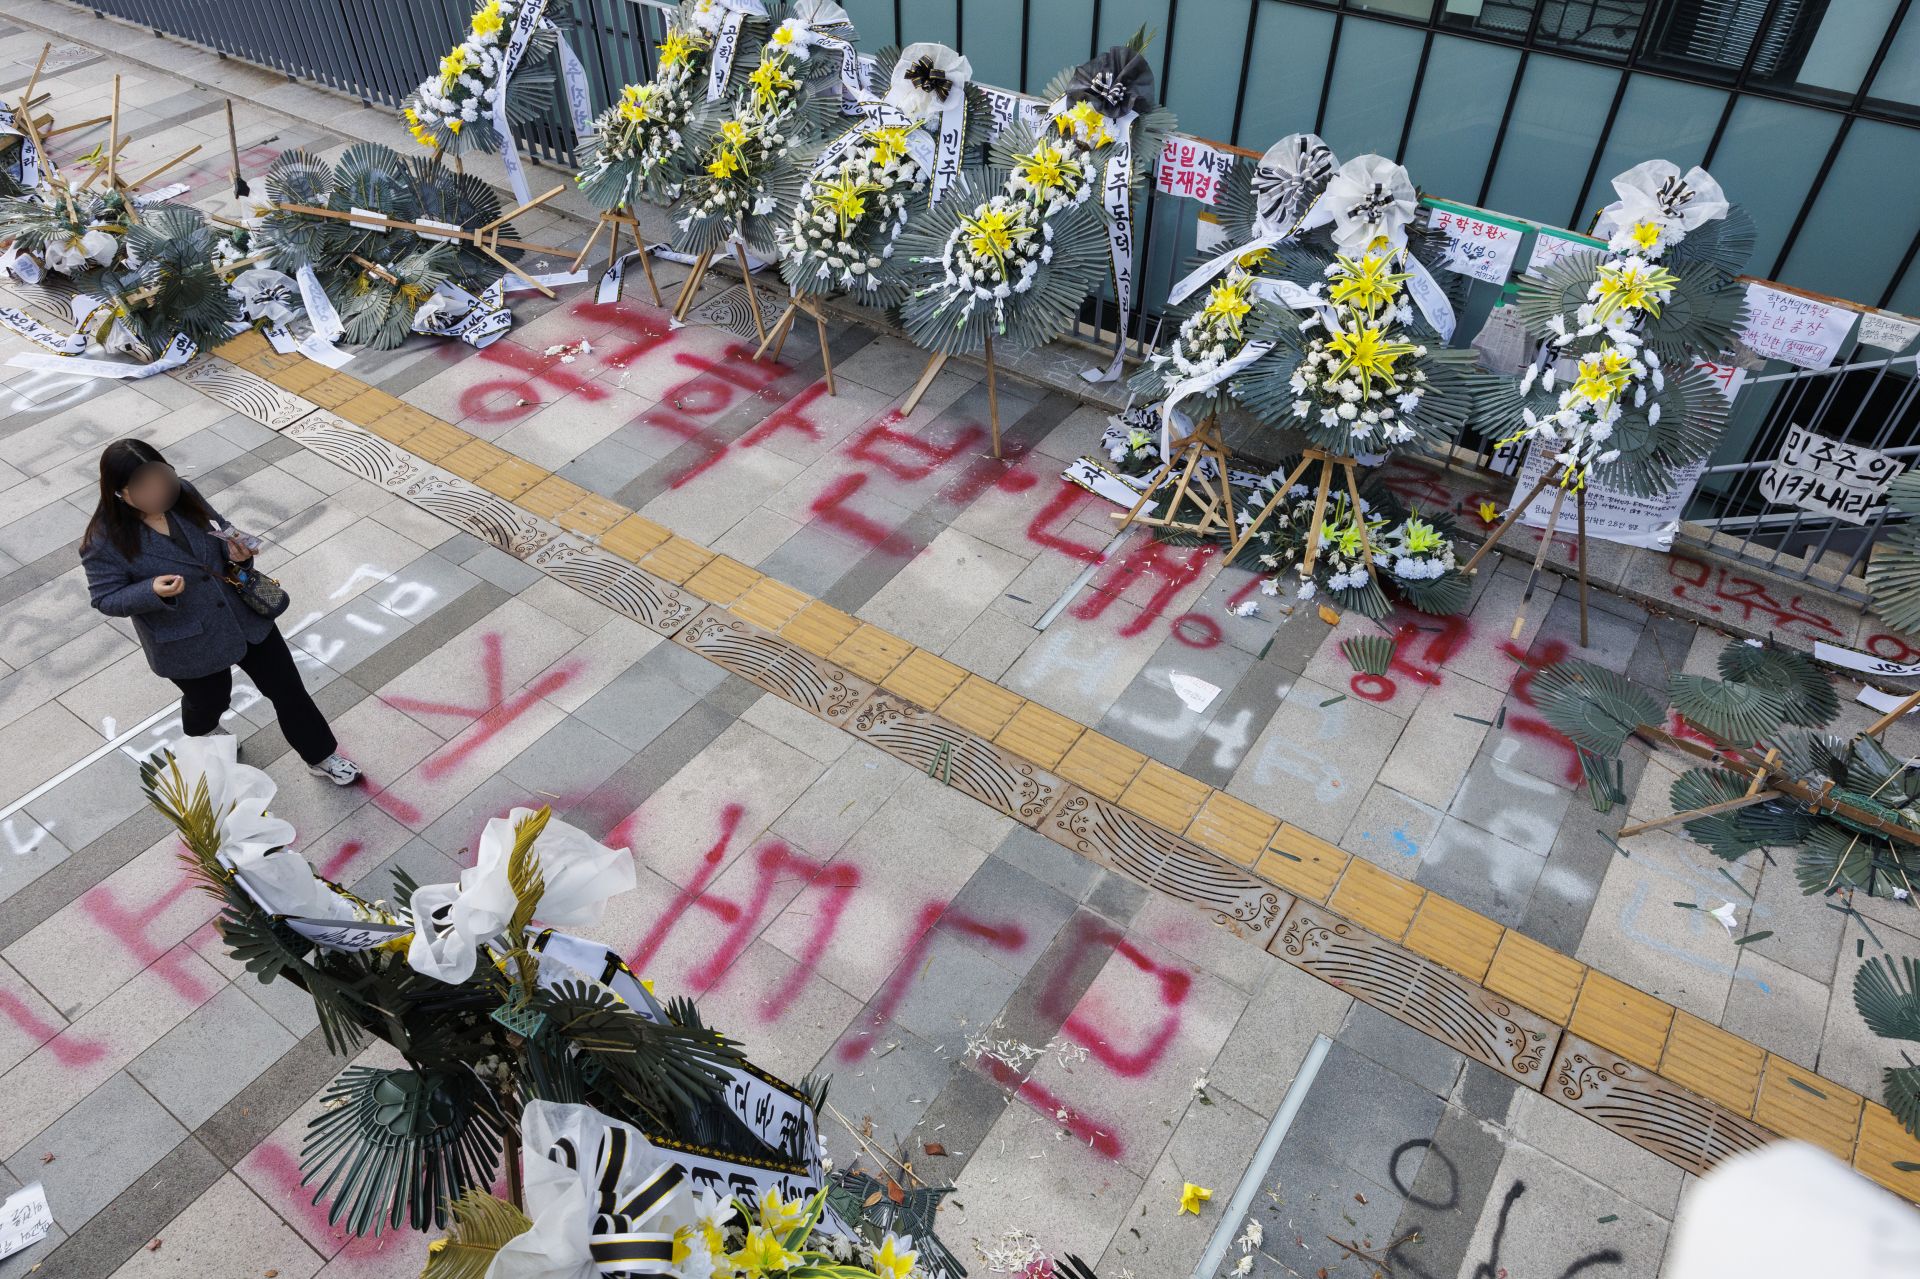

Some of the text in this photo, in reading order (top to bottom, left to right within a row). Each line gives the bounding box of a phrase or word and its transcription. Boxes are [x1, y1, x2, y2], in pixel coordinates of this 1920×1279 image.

[722, 25, 737, 63] 공학
[1163, 141, 1196, 167] 친일
[1749, 308, 1824, 337] 무능한 총장
[1784, 431, 1898, 487] 민주주의
[1765, 467, 1880, 517] 지켜내라
